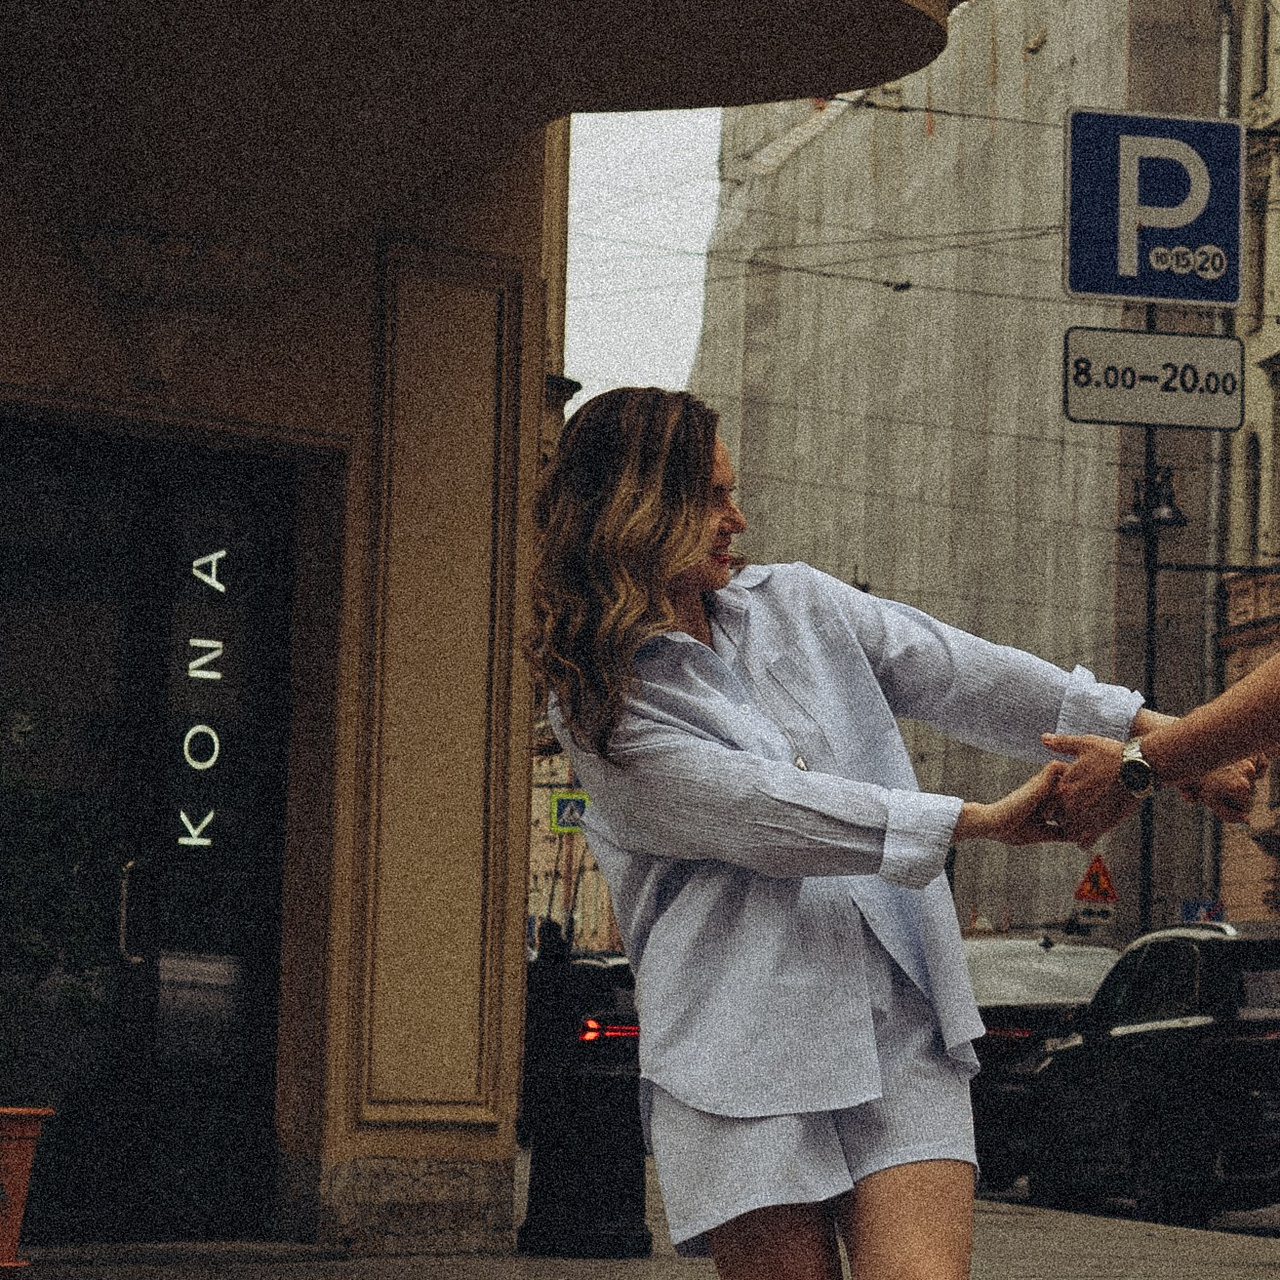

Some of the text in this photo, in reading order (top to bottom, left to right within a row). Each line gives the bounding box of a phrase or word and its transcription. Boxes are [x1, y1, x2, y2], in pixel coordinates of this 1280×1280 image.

[1117, 135, 1211, 277] P
[1174, 250, 1192, 268] 15
[1198, 250, 1225, 273] 20
[178, 549, 227, 846] KONA
